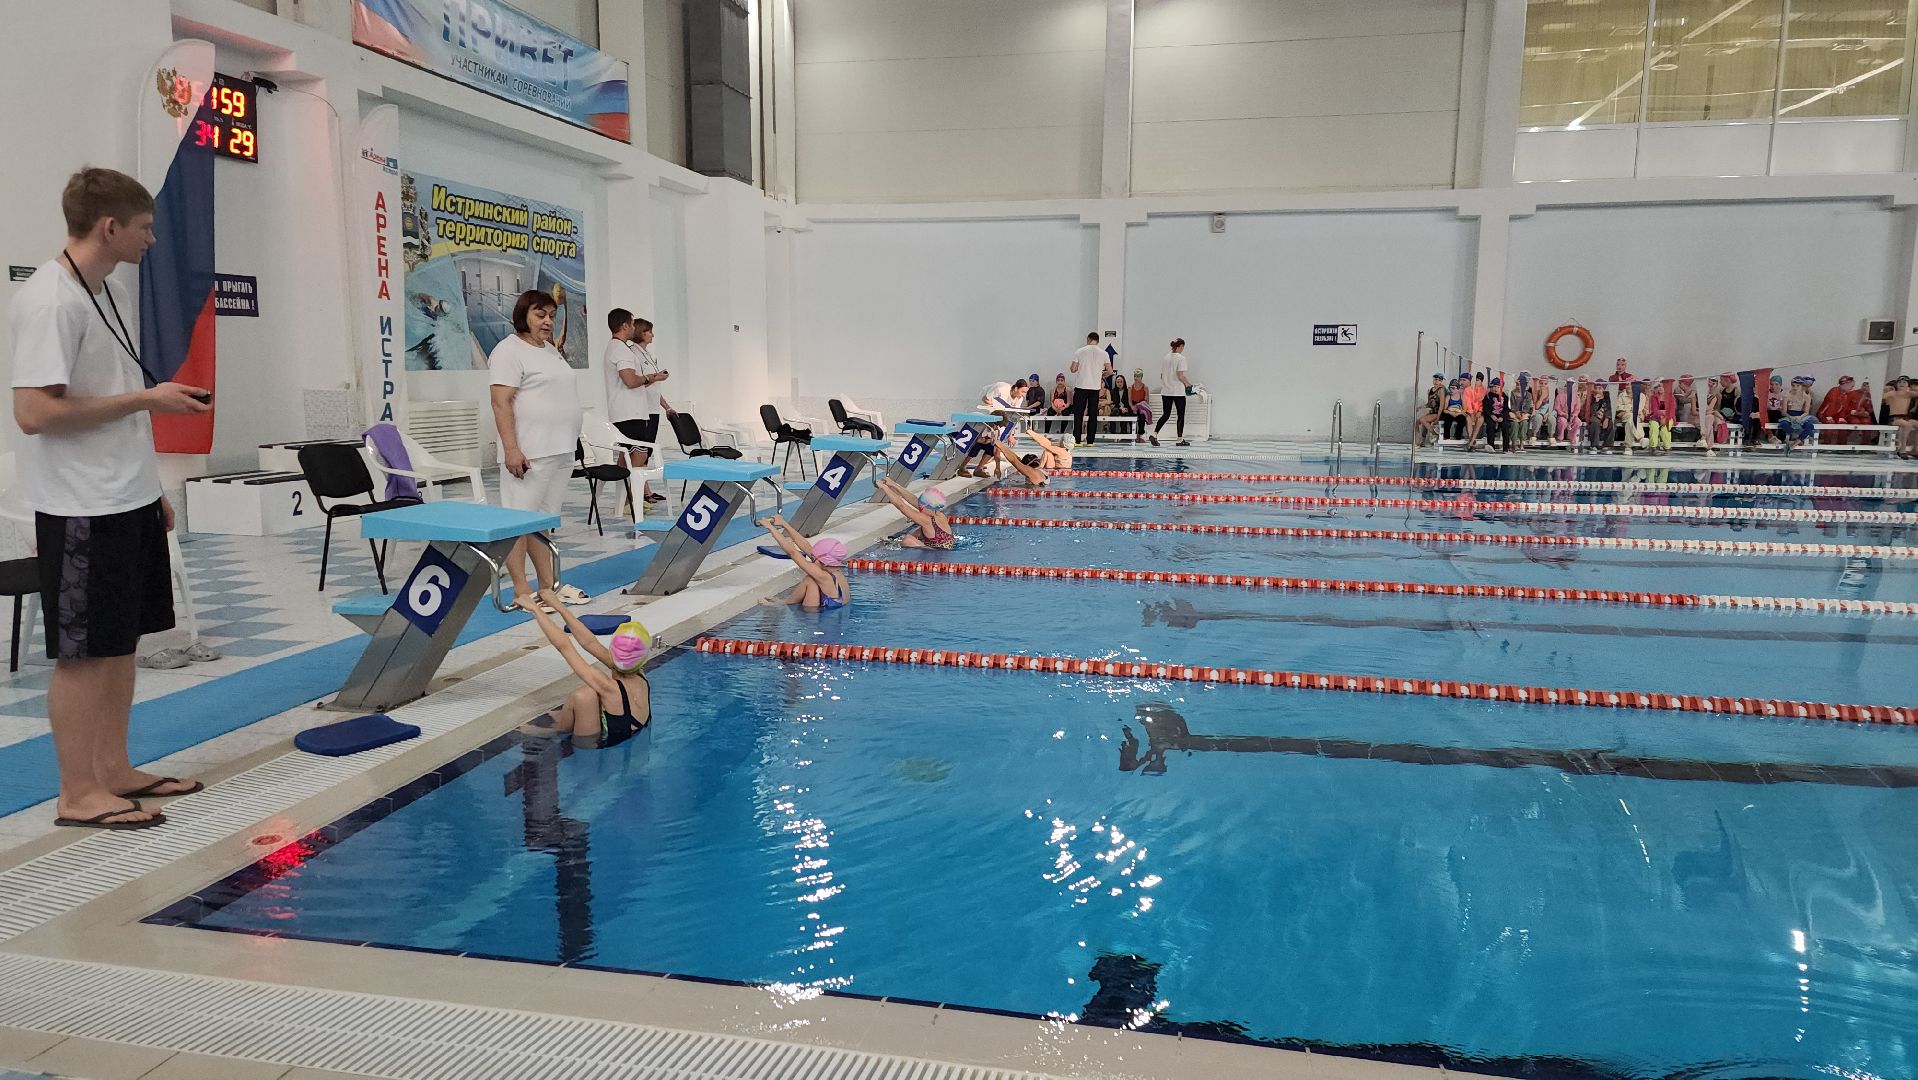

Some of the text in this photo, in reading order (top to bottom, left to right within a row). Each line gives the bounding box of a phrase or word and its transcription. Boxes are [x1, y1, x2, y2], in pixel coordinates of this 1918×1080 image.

[442, 0, 573, 91] ПРИВЕТ
[451, 54, 572, 111] УЧАСТНИКАМ СОРЕВНОВАНИЙ
[230, 128, 254, 156] 29
[432, 184, 529, 228] Истринский
[374, 191, 391, 300] АРЕНА
[436, 217, 577, 260] территория спорта
[222, 281, 253, 293] ПРЫГАТЬ
[379, 315, 394, 421] ИСТРА
[903, 442, 923, 465] 3
[954, 429, 973, 449] 2
[822, 466, 847, 491] 4
[292, 491, 303, 516] 2
[686, 494, 719, 531] 5
[408, 564, 451, 617] 6
